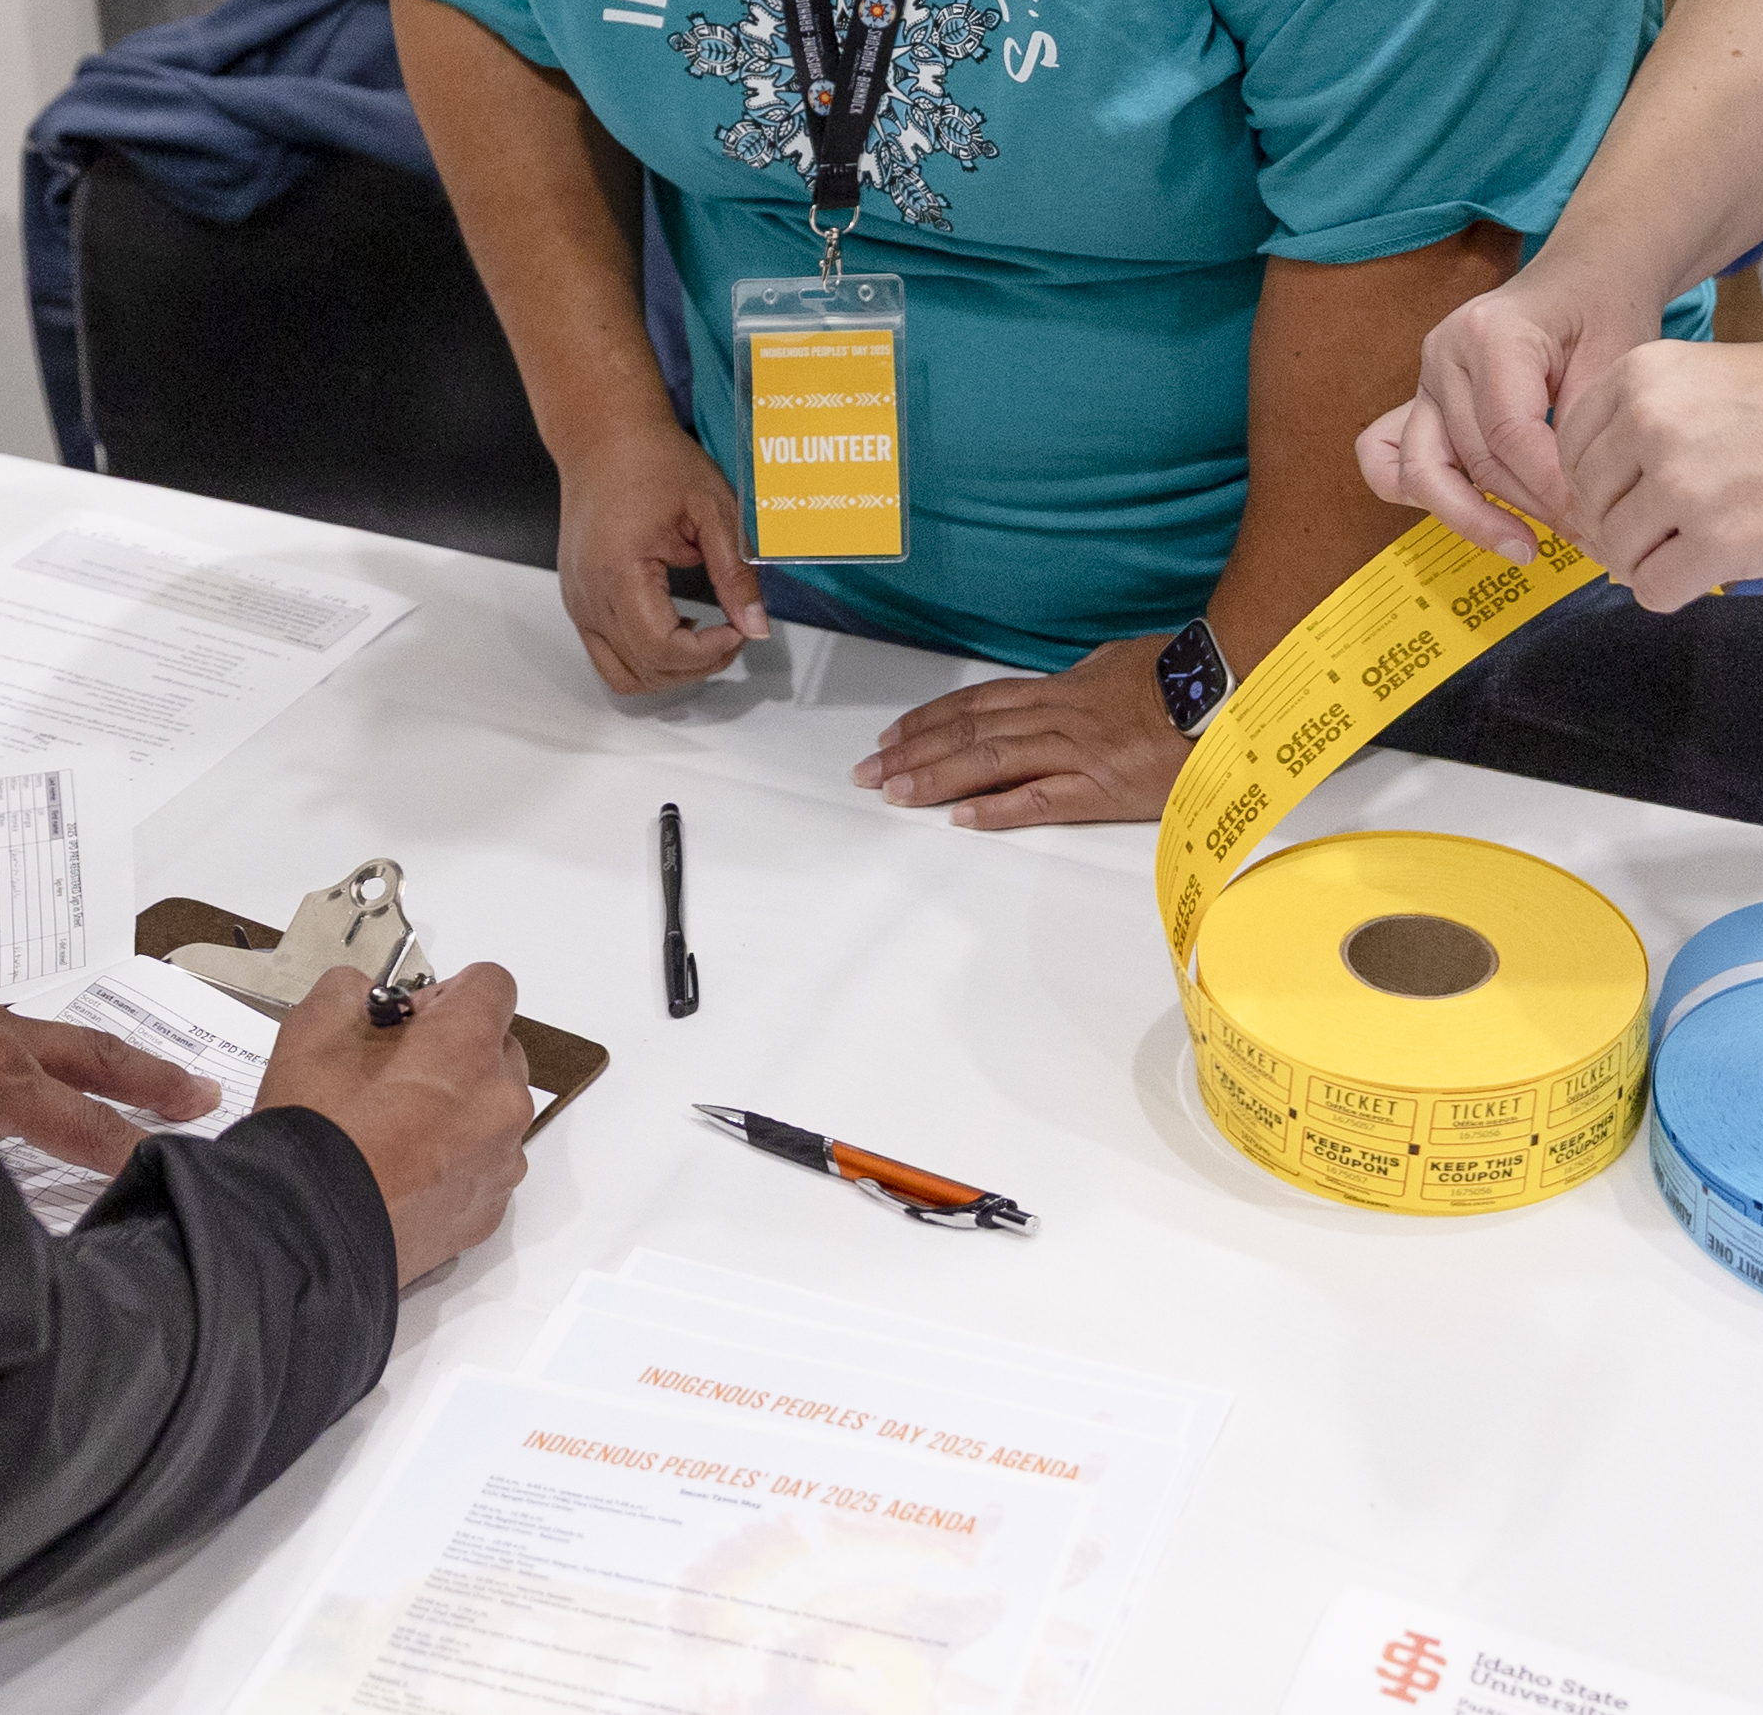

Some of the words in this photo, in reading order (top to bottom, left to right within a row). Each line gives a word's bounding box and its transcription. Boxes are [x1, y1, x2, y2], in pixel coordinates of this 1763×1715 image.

[759, 346, 809, 359] INDIGENOUS
[851, 345, 868, 357] DAY
[870, 344, 891, 356] 2025
[759, 433, 892, 464] VOLUNTEER
[1451, 566, 1523, 617] Office
[1362, 630, 1434, 687] Office
[1276, 703, 1345, 764] Office
[1206, 783, 1261, 850] Office
[1172, 873, 1197, 948] Office
[71, 1002, 102, 1023] Seaman
[80, 993, 101, 1009] Scott
[96, 988, 118, 1003] Last
[117, 999, 140, 1017] name:
[137, 1023, 164, 1046] Denise
[152, 1021, 171, 1037] First
[171, 1032, 197, 1050] name:
[188, 1025, 216, 1043] 2025
[217, 1039, 238, 1055] IPD
[1222, 1025, 1278, 1074] TICKET
[1564, 1054, 1614, 1097] TICKET
[1324, 1084, 1398, 1115] TICKET
[1451, 1097, 1522, 1120] TICKET
[1306, 1131, 1352, 1154] KEEP
[1359, 1150, 1400, 1167] THIS
[1548, 1131, 1586, 1156] KEEP
[1590, 1111, 1615, 1137] THIS
[1555, 1127, 1608, 1164] COUPON
[1314, 1146, 1389, 1176] COUPON
[1430, 1161, 1479, 1172] KEEP
[1486, 1155, 1523, 1170] THIS
[1438, 1167, 1513, 1183] COUPON
[1707, 1233, 1734, 1265] ONE
[637, 1366, 770, 1410] INDIGENOUS
[769, 1394, 878, 1431] PEOPLES'
[876, 1418, 928, 1445] DAY
[926, 1431, 988, 1461] 2025
[986, 1446, 1082, 1481] AGENDA
[522, 1429, 659, 1472] INDIGENOUS
[658, 1455, 770, 1489] PEOPLES'
[769, 1474, 821, 1500] DAY
[819, 1484, 883, 1514] 2025
[881, 1498, 978, 1536] AGENDA
[1474, 1651, 1552, 1687] Idaho
[1559, 1678, 1630, 1710] State
